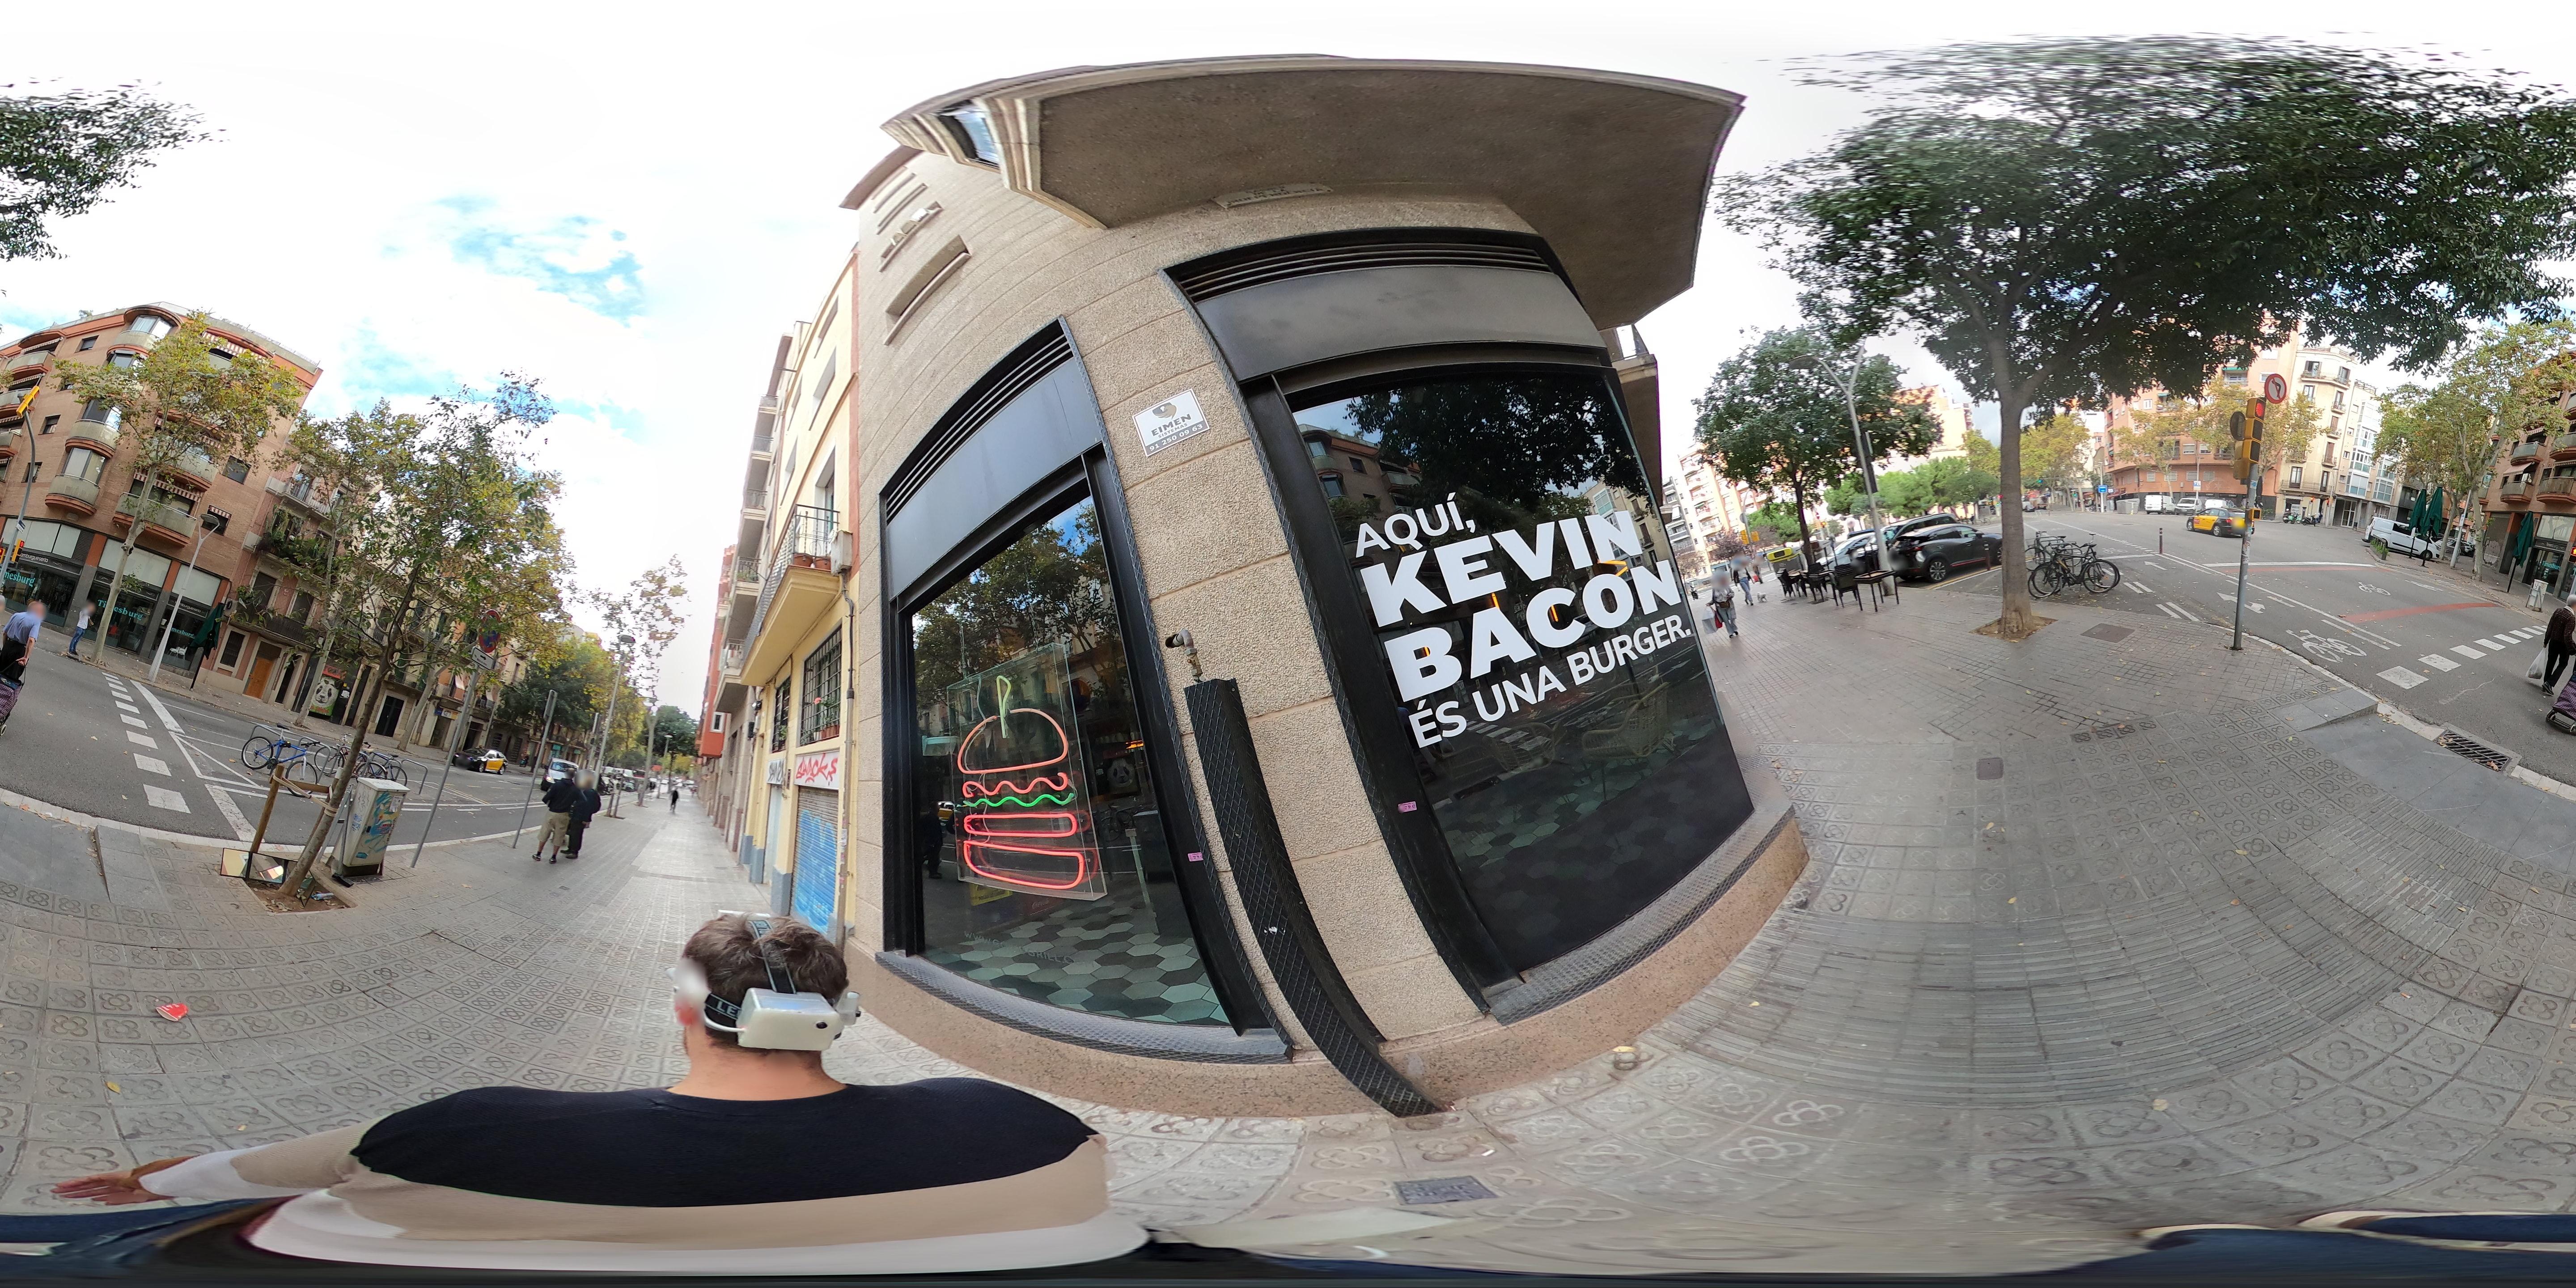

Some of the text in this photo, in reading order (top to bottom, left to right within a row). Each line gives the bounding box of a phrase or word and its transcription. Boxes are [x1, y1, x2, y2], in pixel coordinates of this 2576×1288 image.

[1151, 413, 1191, 436] EIMEN
[1158, 423, 1188, 439] SISTEMAS
[1149, 443, 1160, 452] 91
[1161, 435, 1177, 445] 250
[1179, 429, 1190, 437] 09
[1356, 492, 1476, 558] AQUÍ,
[20, 552, 49, 563] amburgueseria
[1360, 510, 1643, 627] KEVIN
[4, 571, 36, 587] mesburg
[97, 599, 144, 621] Tiesburg
[171, 627, 195, 638] mesburg
[1384, 560, 1682, 703] BACON
[1409, 614, 1691, 749] ÉS UNA BURGER.
